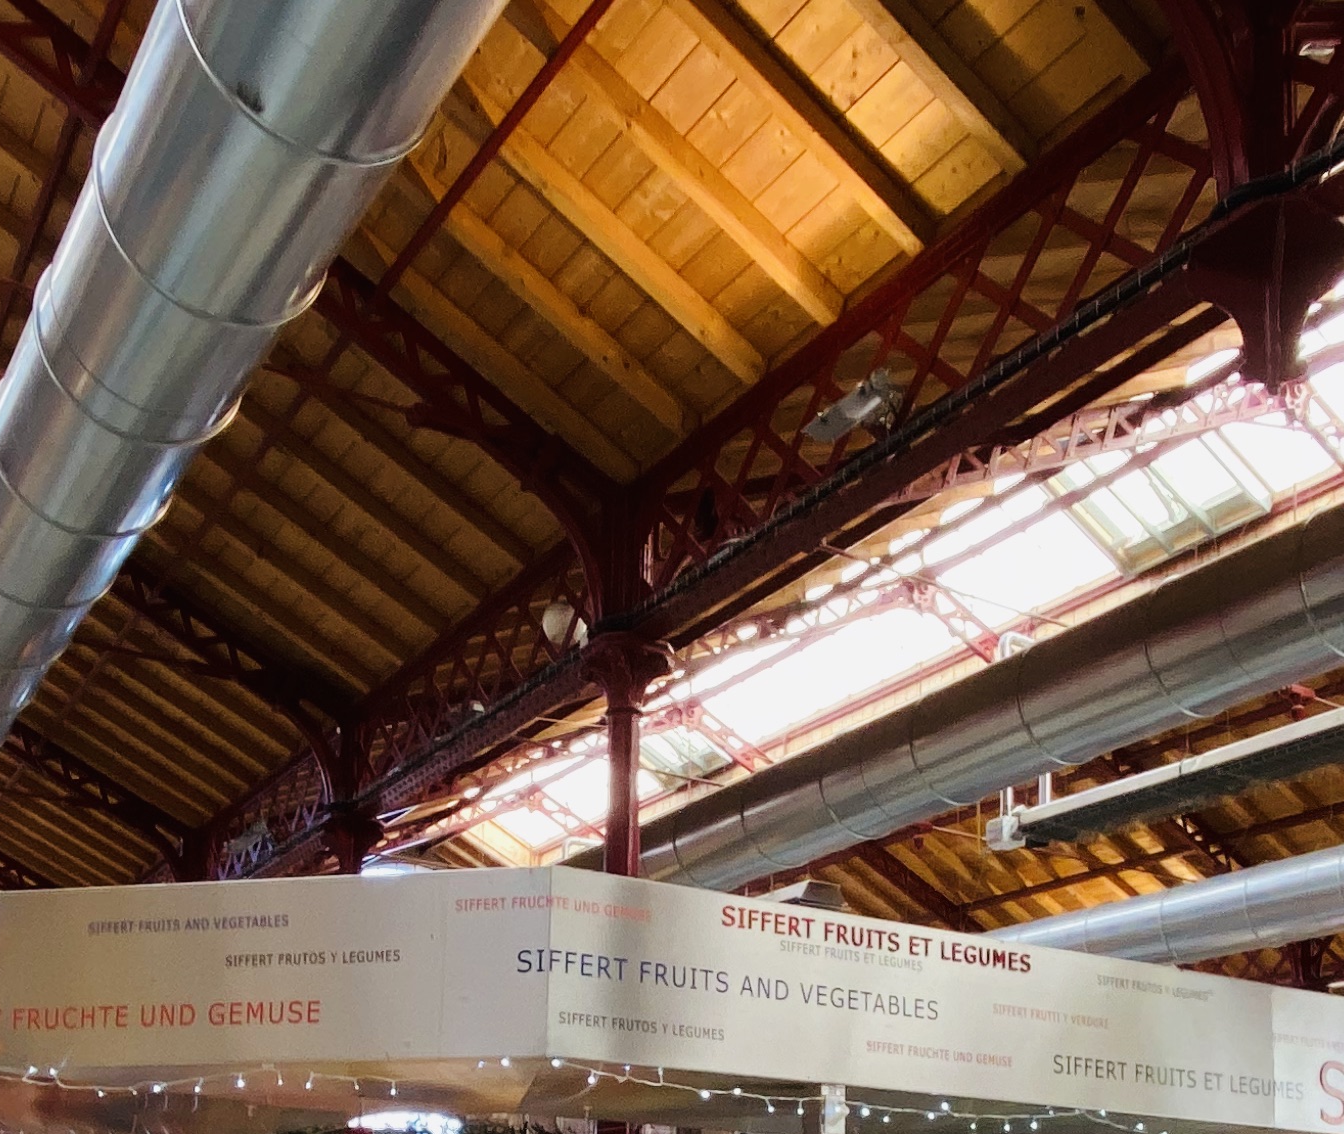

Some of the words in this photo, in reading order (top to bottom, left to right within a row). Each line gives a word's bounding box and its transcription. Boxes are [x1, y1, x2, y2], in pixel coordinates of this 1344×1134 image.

[455, 896, 505, 912] SIFFERT
[511, 895, 569, 910] FRUCHTE
[574, 899, 600, 913] UND
[88, 920, 134, 937] SIFFERT
[184, 917, 210, 932] AND
[213, 914, 290, 931] VEGETABLES
[722, 905, 815, 939] SIFFERT
[824, 922, 900, 953] FRUITS
[909, 935, 933, 957] ET
[940, 941, 1032, 974] LEGUMES
[224, 952, 274, 969] SIFFERT
[329, 952, 338, 964] Y
[342, 949, 401, 965] LEGUMES
[780, 940, 821, 956] SIFFERT
[824, 946, 860, 963] FRUITS
[863, 952, 876, 965] ET
[878, 954, 924, 973] LEGUMES
[517, 949, 628, 981] SIFFERT
[639, 961, 729, 993] FRUITS
[740, 975, 789, 1000] AND
[799, 982, 939, 1021] VEGETABLES
[12, 1005, 128, 1031] FRUCHTE
[140, 1003, 196, 1027] UND
[208, 1000, 322, 1026] GEMUSE
[993, 1003, 1027, 1018] SIFFERT
[559, 1011, 608, 1029] SIFFERT
[611, 1017, 657, 1034] FRUTOS
[661, 1023, 669, 1035] Y
[672, 1024, 725, 1041] LEGUMES
[866, 1040, 904, 1056] SIFFERT
[908, 1044, 950, 1061] FRUCHTE
[953, 1049, 973, 1064] UND
[976, 1052, 1013, 1068] GEMUSE
[1053, 1054, 1127, 1081] SIFFERT
[1135, 1063, 1197, 1089] FRUITS
[1204, 1071, 1223, 1091] ET
[1229, 1074, 1304, 1100] LEGUMES
